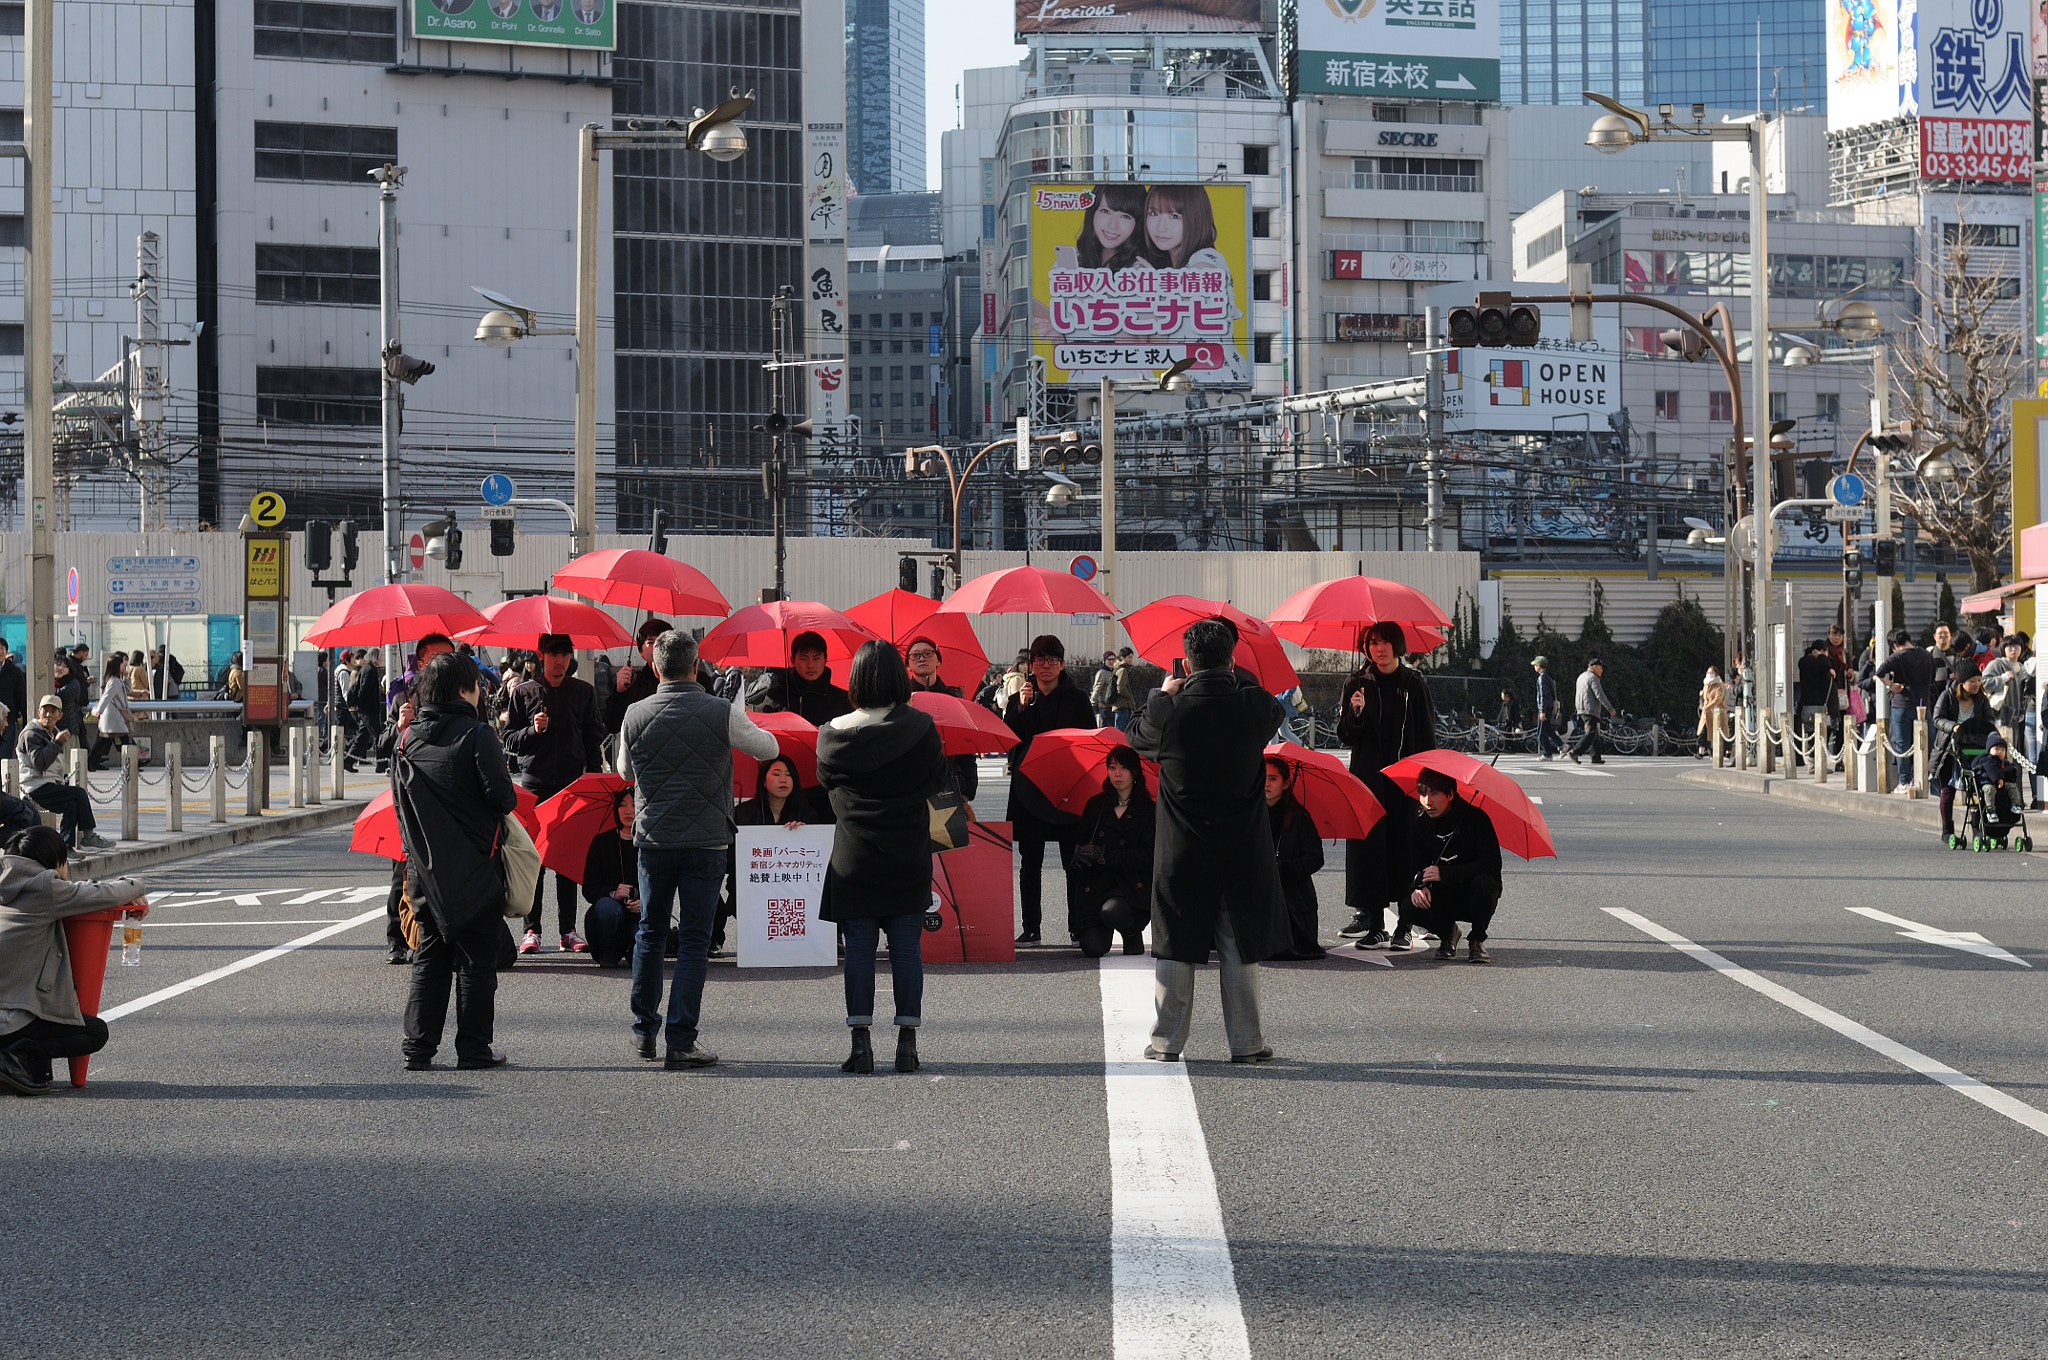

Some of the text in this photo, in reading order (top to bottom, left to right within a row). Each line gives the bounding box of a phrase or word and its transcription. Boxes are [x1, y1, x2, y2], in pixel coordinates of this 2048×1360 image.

[1037, 0, 1116, 21] Precious
[427, 15, 477, 30] Dr. Asano
[491, 21, 518, 31] Dr. Pohl
[527, 23, 538, 32] Dr.
[574, 27, 602, 36] Dr. Sato
[1326, 59, 1430, 90] 新宿本校
[1930, 27, 2032, 114] 鉄人
[1378, 131, 1438, 147] SECRE
[1340, 258, 1358, 271] 7F
[1413, 260, 1448, 273] 鍋ぞう
[1052, 271, 1223, 293] 高収入お仕事情報
[1798, 263, 1813, 282] &
[1828, 263, 1902, 285] コミック
[811, 267, 843, 333] 魚民
[1053, 296, 1225, 332] いちごナビ
[1061, 349, 1177, 365] いちごナビ 求人
[1540, 363, 1606, 383] OPEN
[1541, 388, 1607, 405] HOUSE
[819, 427, 840, 466] 天狗
[257, 495, 277, 521] 2
[483, 508, 513, 516] 歩行者優先
[1834, 508, 1865, 518] 歩行者優先
[249, 578, 277, 586] はとバス
